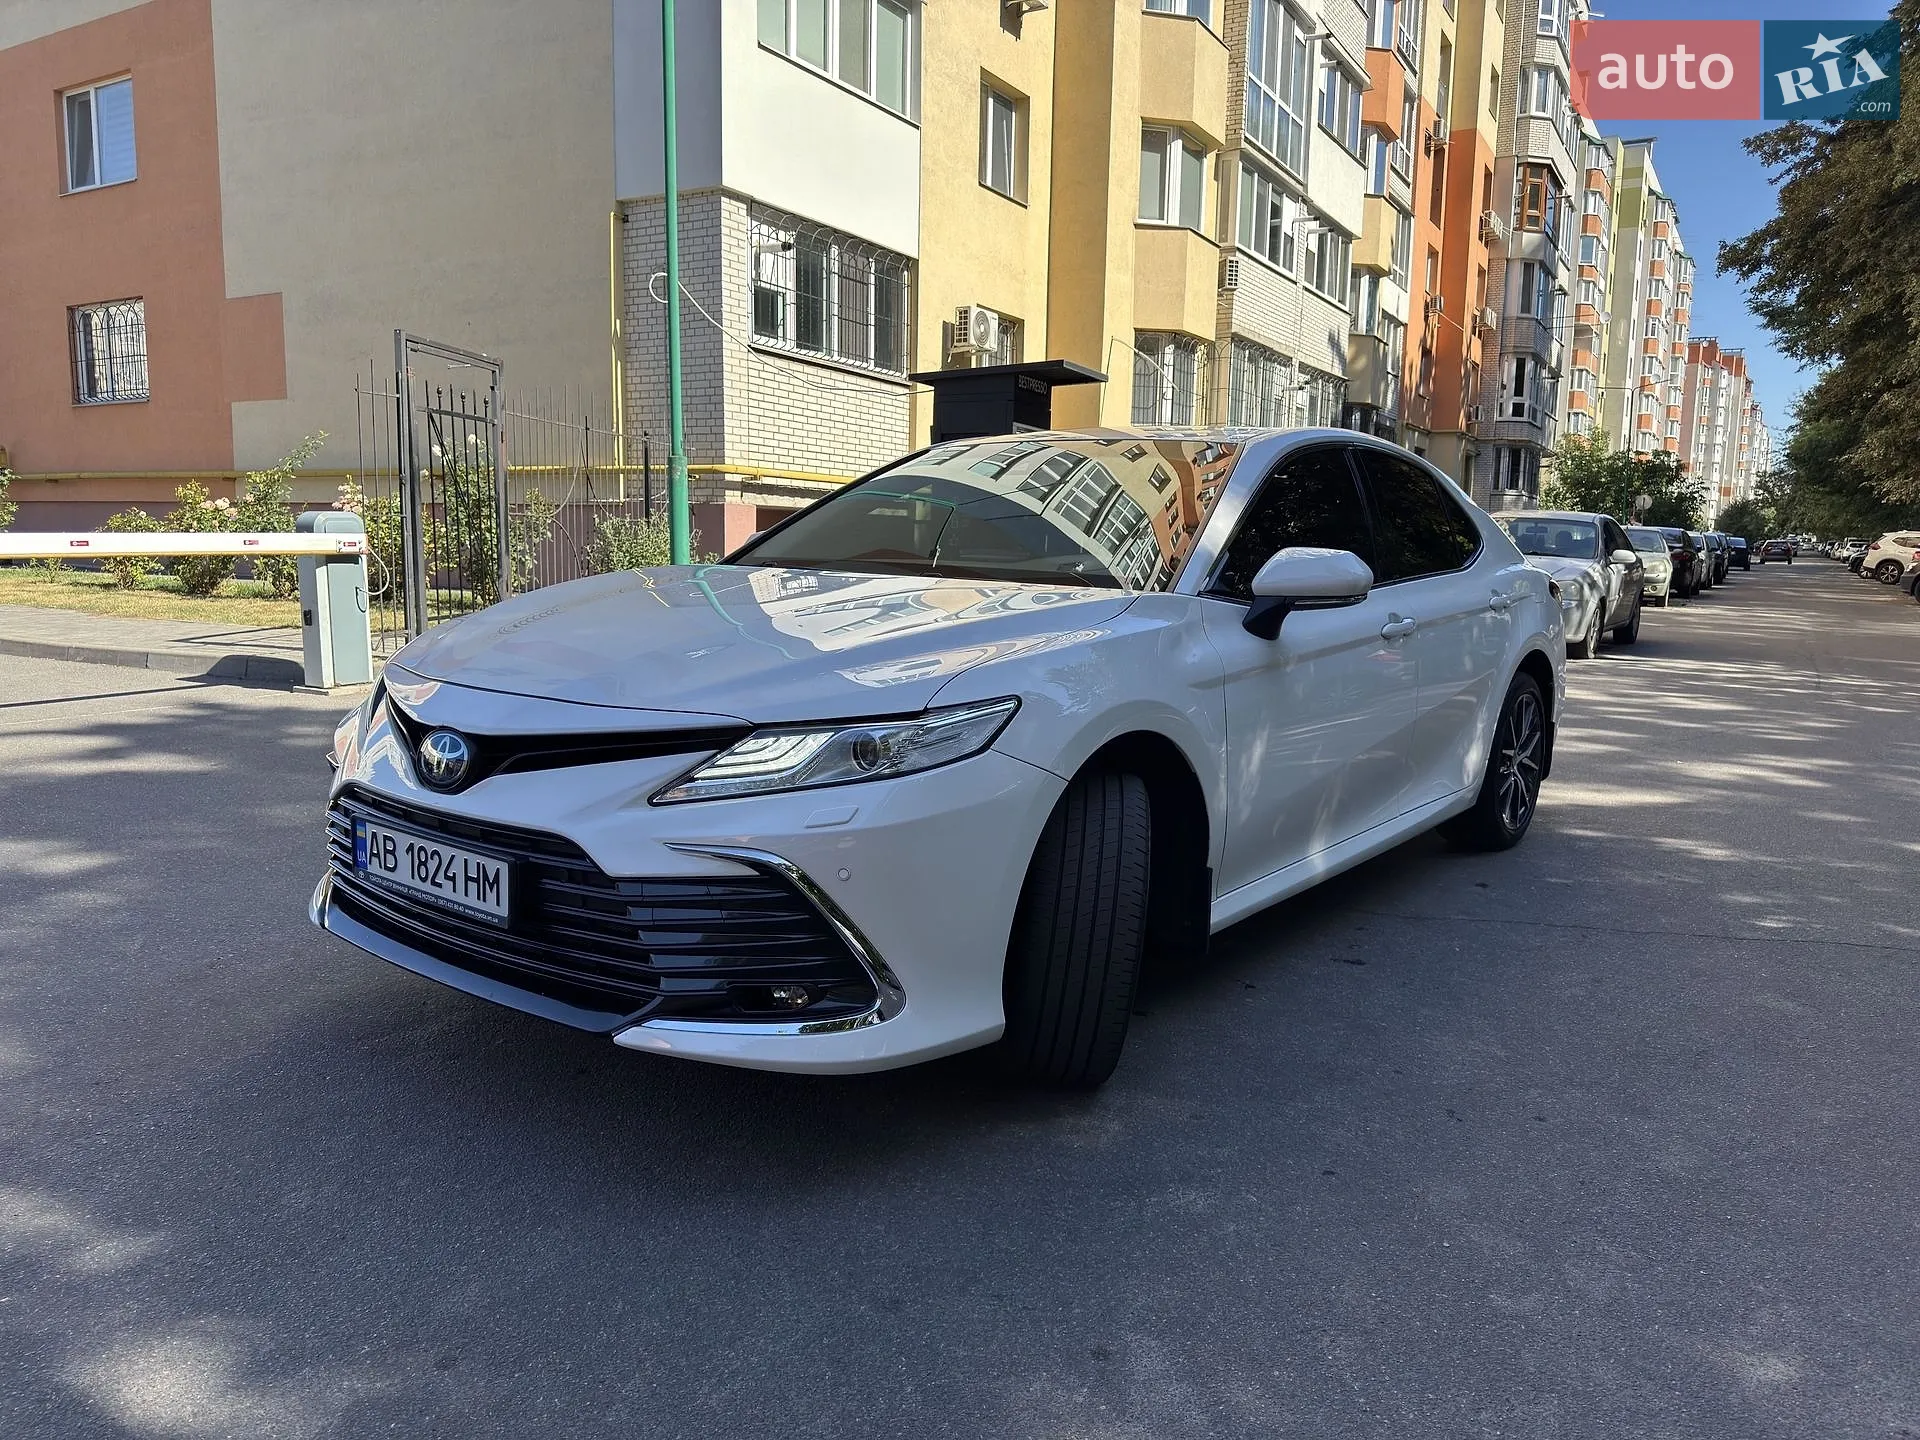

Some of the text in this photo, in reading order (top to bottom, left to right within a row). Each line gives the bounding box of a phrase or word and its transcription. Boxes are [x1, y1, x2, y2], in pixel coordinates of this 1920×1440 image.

[1018, 374, 1048, 395] BESTPRESSO
[357, 851, 367, 863] UA
[369, 830, 398, 873] AB
[405, 841, 456, 893] 1824
[463, 856, 500, 907] HM
